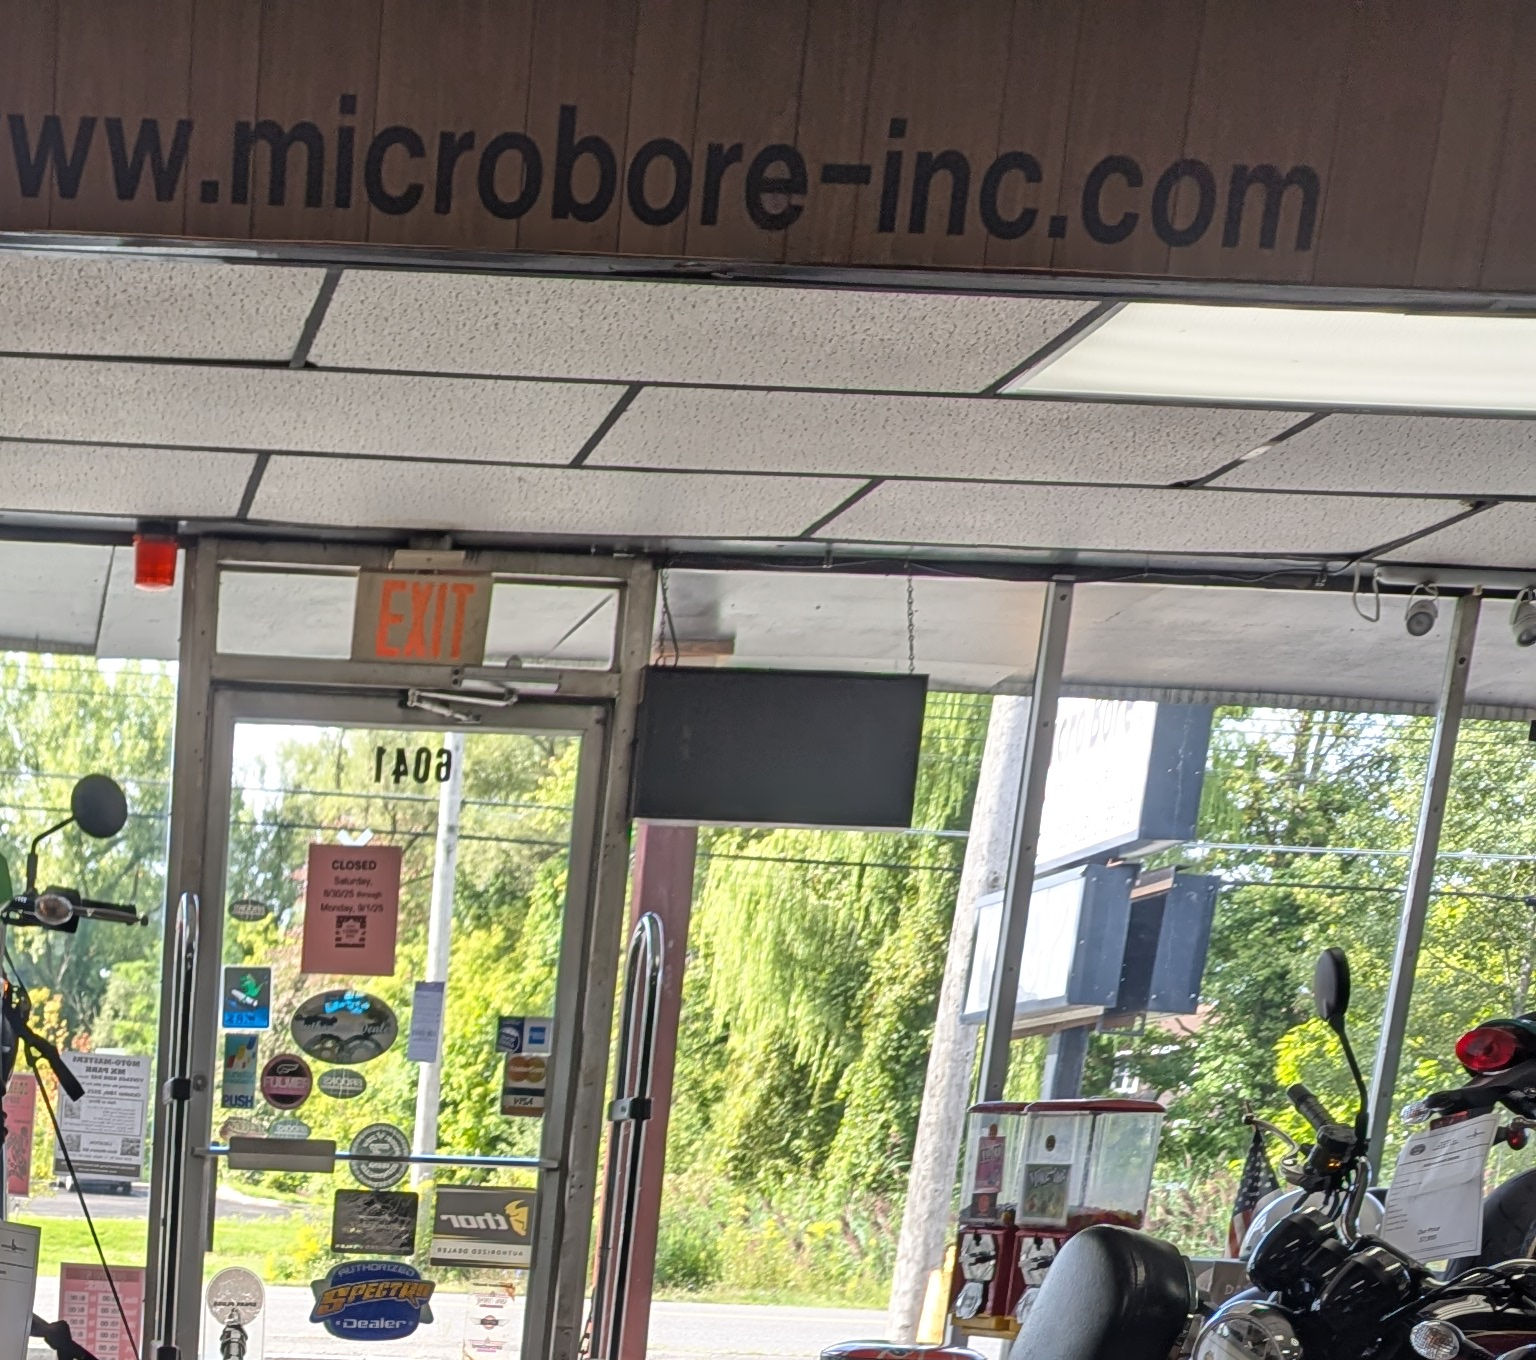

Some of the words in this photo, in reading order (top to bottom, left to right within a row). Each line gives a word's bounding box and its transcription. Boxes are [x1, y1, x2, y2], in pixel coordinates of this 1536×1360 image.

[374, 580, 475, 660] EXIT
[331, 859, 377, 870] CLOSED
[333, 876, 373, 887] Saturday,
[320, 903, 355, 913] Monday,
[223, 1094, 254, 1108] PUSH
[513, 1097, 534, 1106] VISA
[337, 1263, 415, 1278] AUTHORIZED
[342, 1316, 407, 1329] Dealer
